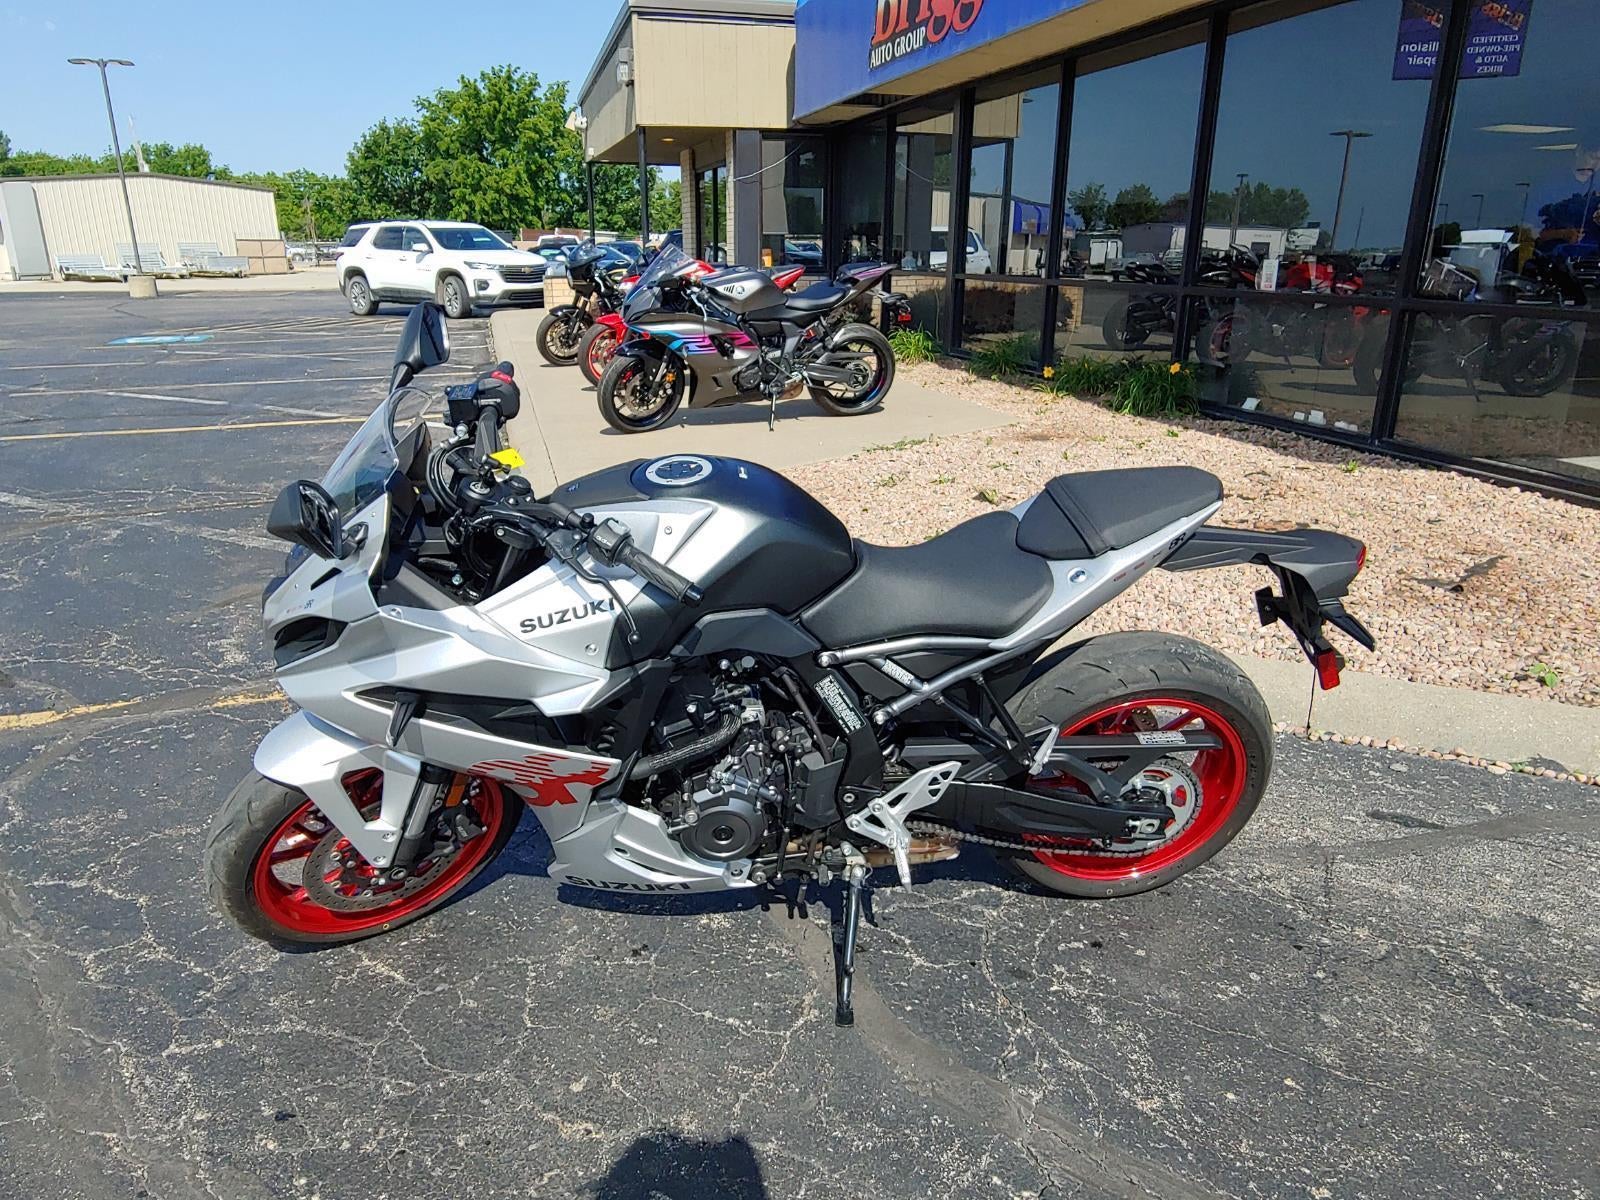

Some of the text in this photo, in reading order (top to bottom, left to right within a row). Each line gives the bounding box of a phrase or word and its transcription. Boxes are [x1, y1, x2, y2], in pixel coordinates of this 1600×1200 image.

[870, 26, 926, 68] AUTO GROUP
[519, 597, 615, 634] SUZUKI
[565, 875, 691, 892] SUZUKI
